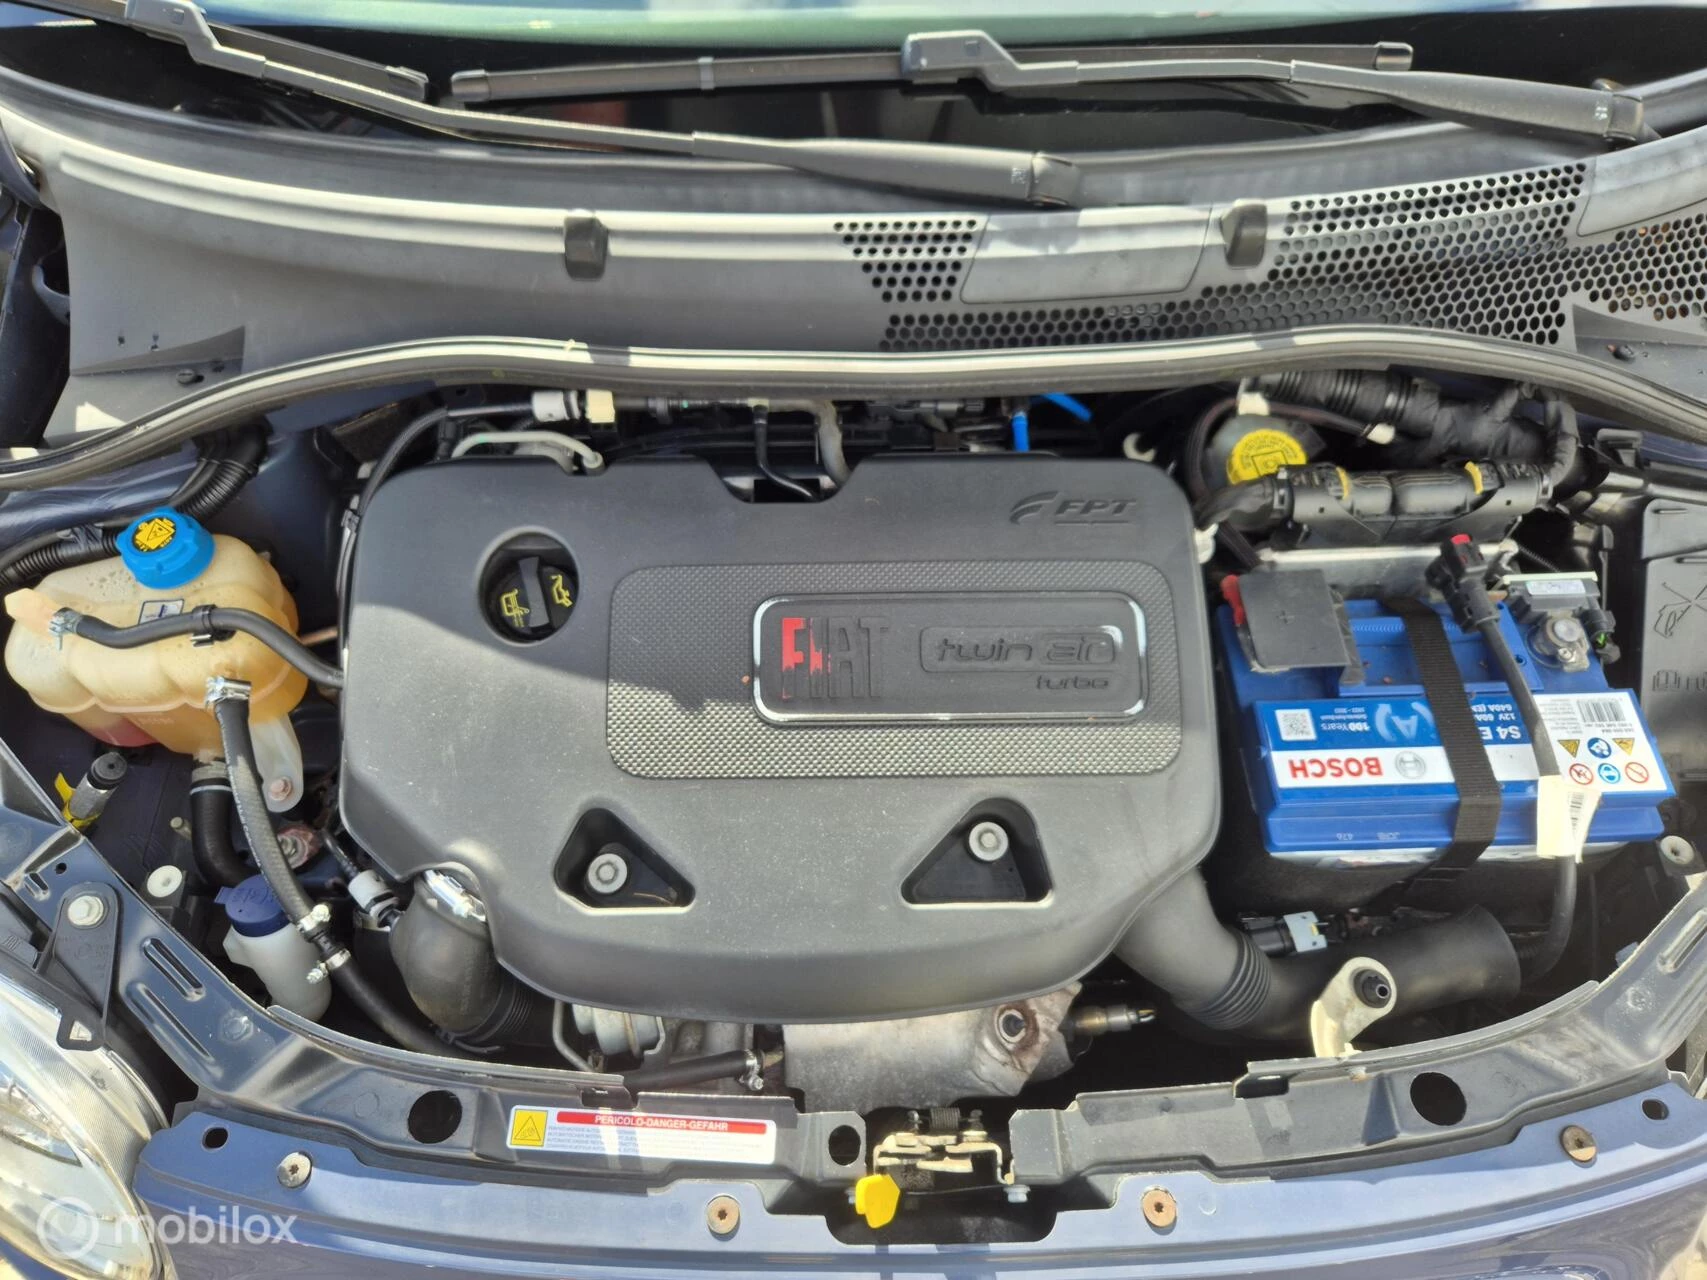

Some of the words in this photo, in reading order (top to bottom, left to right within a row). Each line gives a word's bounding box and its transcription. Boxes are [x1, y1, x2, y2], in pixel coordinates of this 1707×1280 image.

[1055, 499, 1137, 517] FPT
[781, 616, 889, 700] FIAT
[938, 638, 1033, 662] twin
[1036, 674, 1110, 690] turbo
[1496, 725, 1522, 740] S4
[1287, 756, 1383, 779] BOSCH
[594, 1114, 729, 1132] PERICOLO-DANGER-GEFAHR
